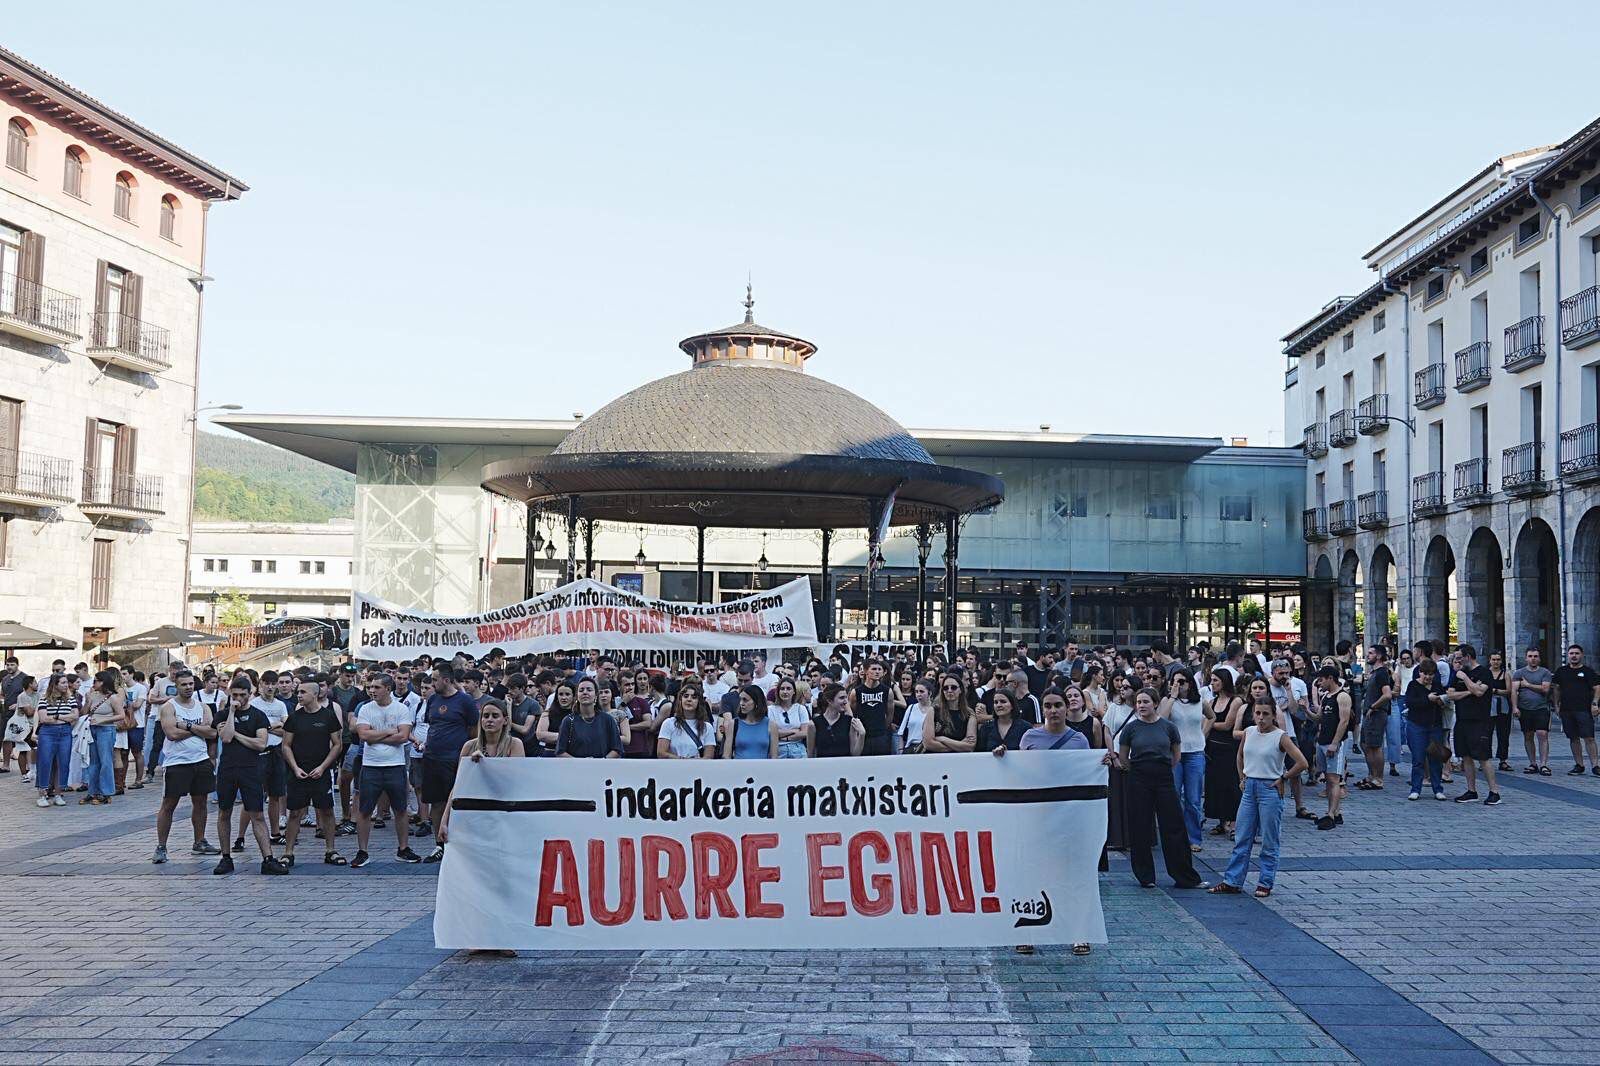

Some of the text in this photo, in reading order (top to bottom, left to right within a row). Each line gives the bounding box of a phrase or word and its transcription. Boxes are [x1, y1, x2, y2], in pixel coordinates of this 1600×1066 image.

[528, 594, 571, 614] artxibo
[750, 594, 784, 613] gizon
[361, 628, 386, 647] bat
[387, 628, 439, 647] atxilotu
[441, 629, 474, 647] dute.
[477, 612, 562, 644] INDARKERIA
[566, 608, 665, 634] MATXISTARI
[768, 620, 790, 633] itaia
[861, 691, 884, 704] EVERLAST
[605, 774, 950, 821] indarkeria matxistari
[535, 829, 1002, 927] AURRE EGIN!
[1011, 898, 1047, 916] itaia
